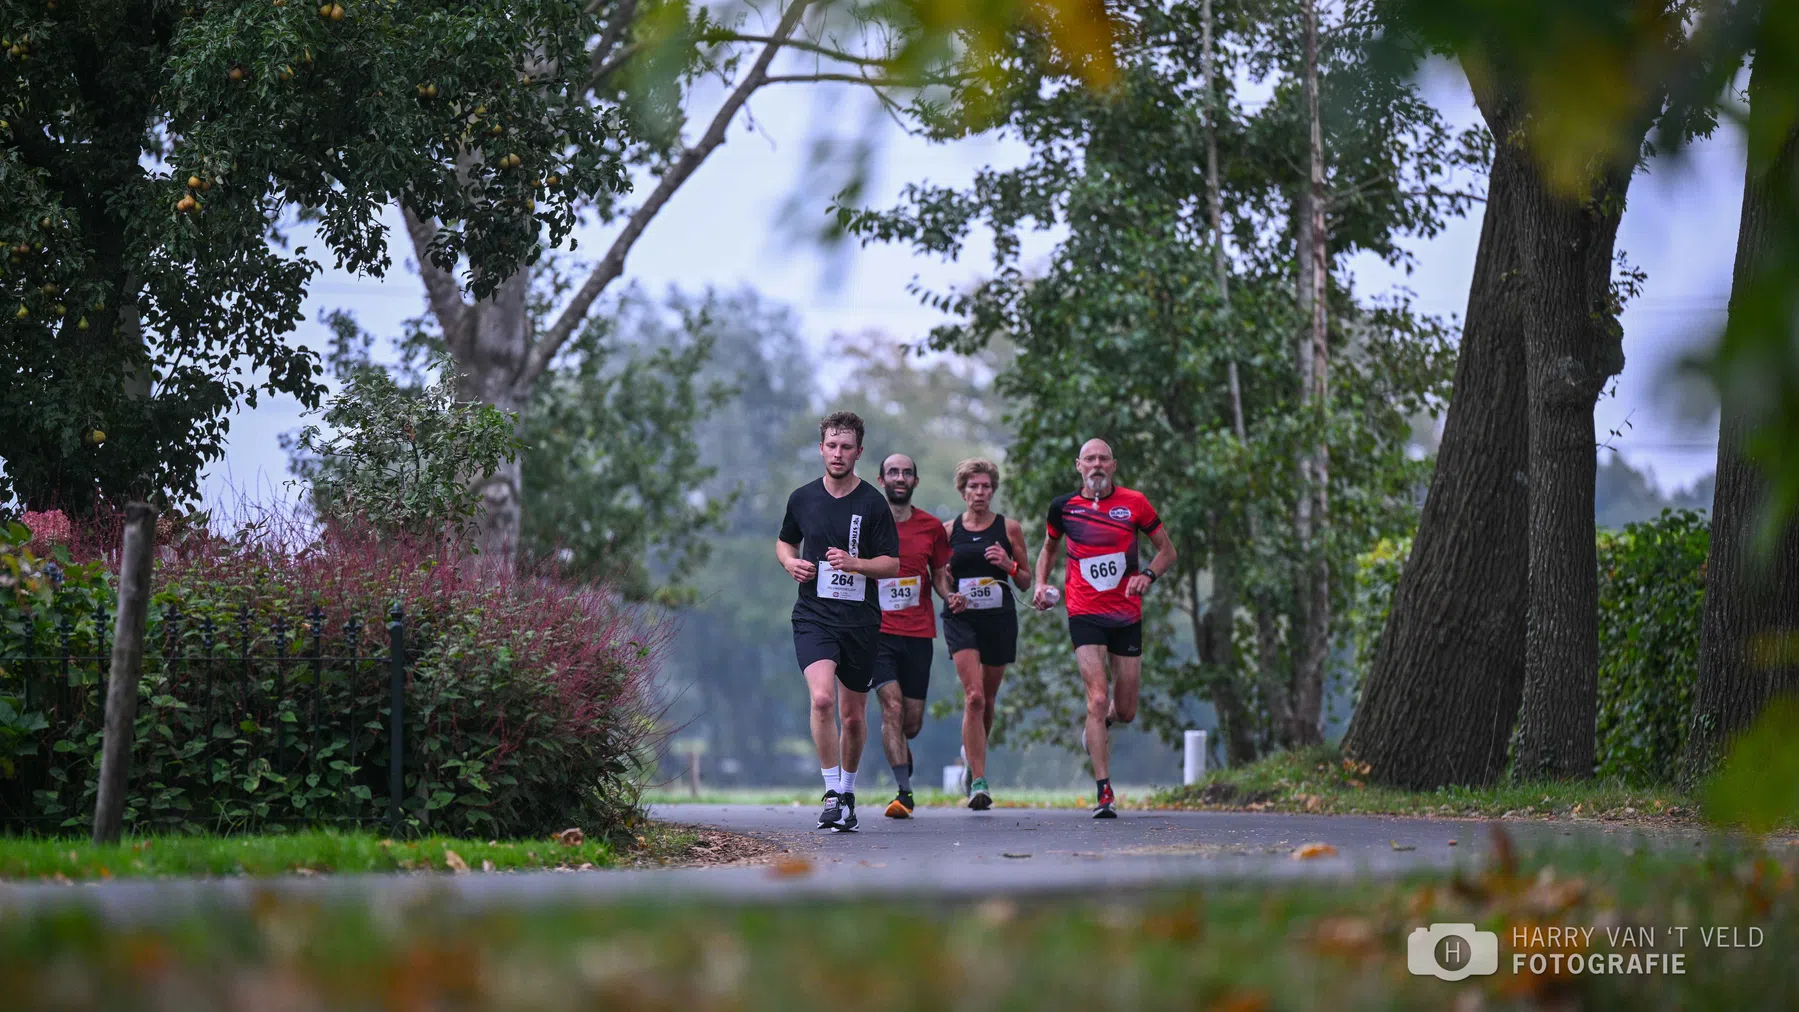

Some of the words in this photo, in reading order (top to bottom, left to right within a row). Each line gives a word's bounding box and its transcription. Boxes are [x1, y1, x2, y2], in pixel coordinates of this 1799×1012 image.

[1090, 560, 1117, 579] 666
[830, 573, 854, 586] 264
[890, 587, 911, 598] 343
